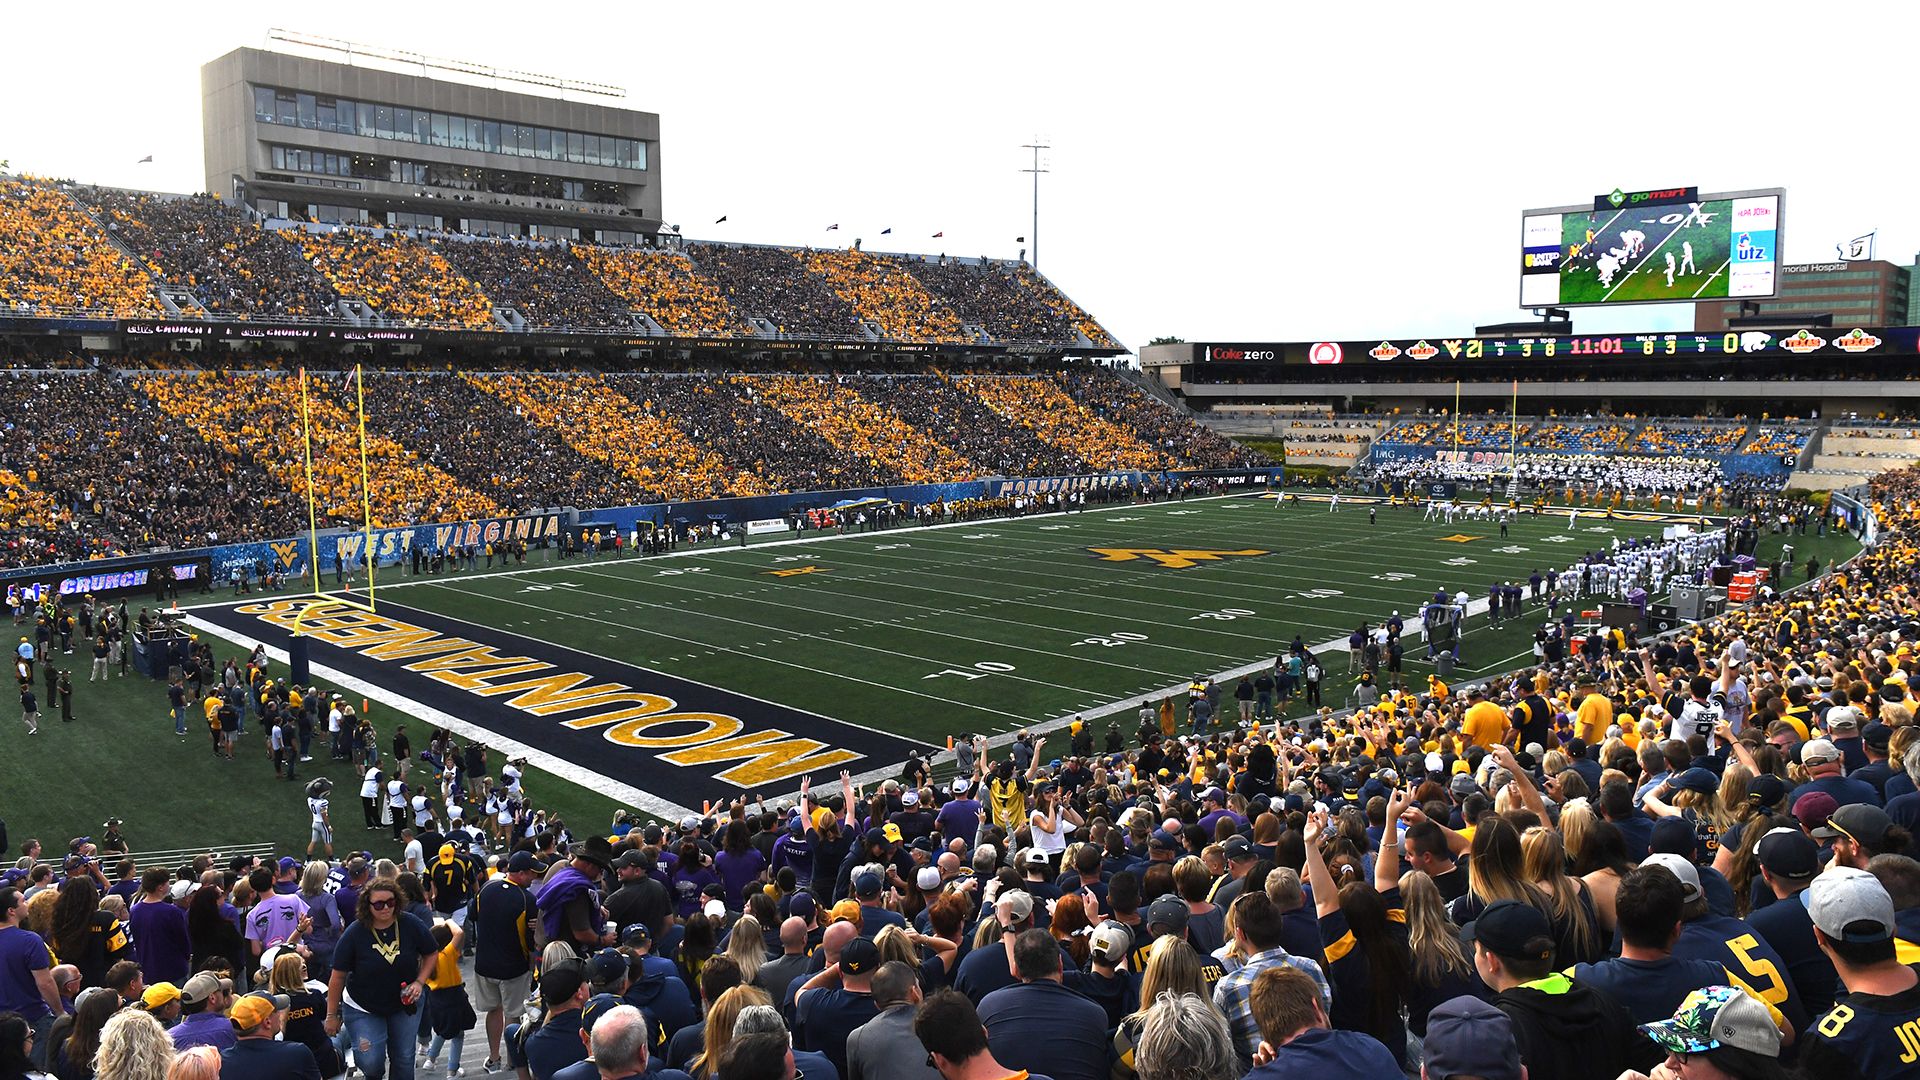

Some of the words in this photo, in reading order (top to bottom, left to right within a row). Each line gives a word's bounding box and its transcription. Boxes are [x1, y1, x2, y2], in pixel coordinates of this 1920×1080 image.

[1630, 187, 1688, 203] gomart
[1811, 262, 1848, 272] Hospital
[1466, 339, 1483, 359] 21
[1522, 343, 1532, 358] 3
[1545, 343, 1556, 357] 8
[1570, 337, 1624, 355] 11:01
[1665, 340, 1676, 355] 3
[1723, 333, 1739, 354] 0
[1786, 339, 1821, 348] TEXAS
[1840, 338, 1876, 347] TEXAS
[1212, 347, 1244, 361] Coke
[1244, 350, 1275, 361] zero
[1375, 449, 1396, 459] IMG
[1435, 451, 1468, 465] THE
[1784, 456, 1795, 466] 15
[336, 530, 415, 559] WEST
[436, 515, 559, 550] VIRGINIA
[222, 557, 260, 569] NISSAN
[60, 568, 149, 595] CRUNCH
[1084, 631, 1149, 648] 20
[938, 661, 1016, 681] 10
[232, 597, 868, 790] MOUNTAINEERS
[444, 869, 454, 886] 7
[1725, 933, 1789, 1005] 5
[287, 1006, 314, 1021] RSON
[1817, 1003, 1855, 1039] 8
